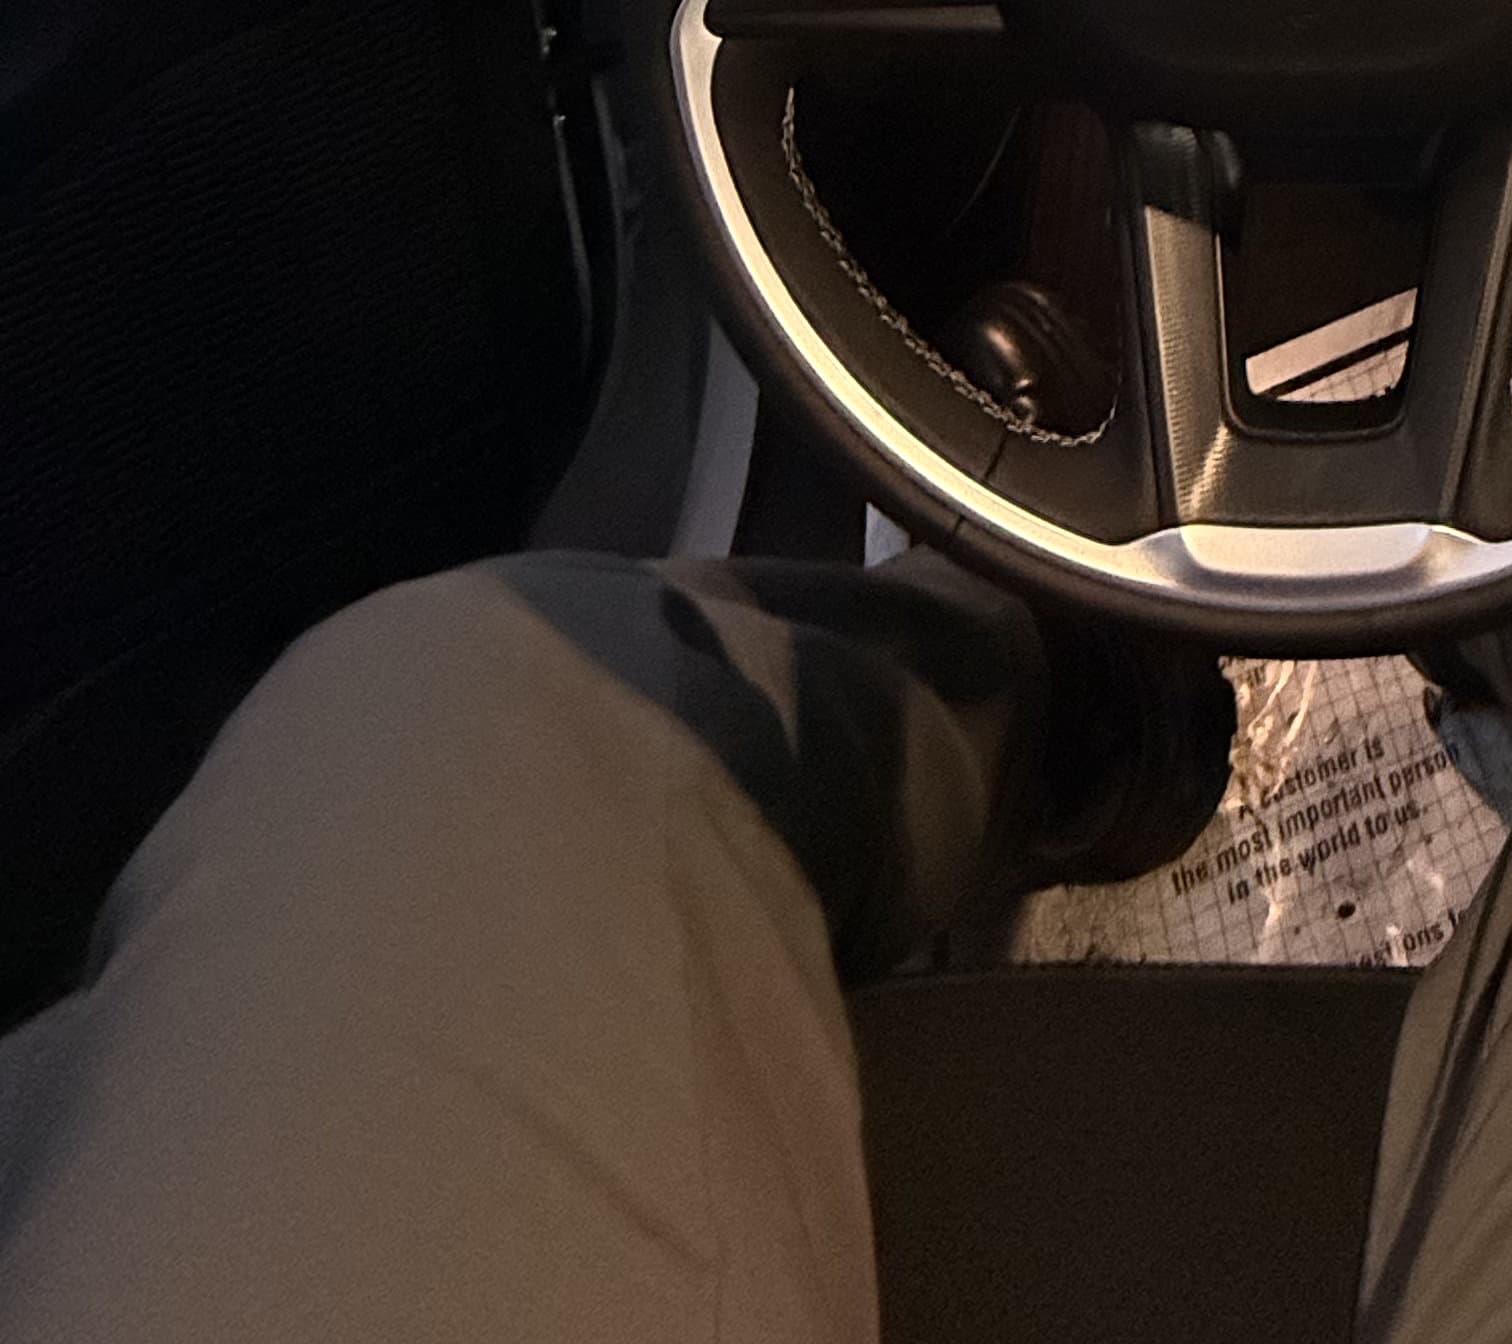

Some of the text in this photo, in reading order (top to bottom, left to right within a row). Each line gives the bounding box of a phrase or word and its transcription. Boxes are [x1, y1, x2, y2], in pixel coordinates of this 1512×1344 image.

[1260, 752, 1358, 810] customer
[1365, 736, 1385, 761] is
[1171, 860, 1209, 897] the
[1216, 823, 1273, 874] most
[1278, 776, 1386, 840] important
[1227, 877, 1250, 904] in
[1254, 856, 1293, 888] the
[1298, 823, 1362, 875] world
[1363, 814, 1389, 841] to
